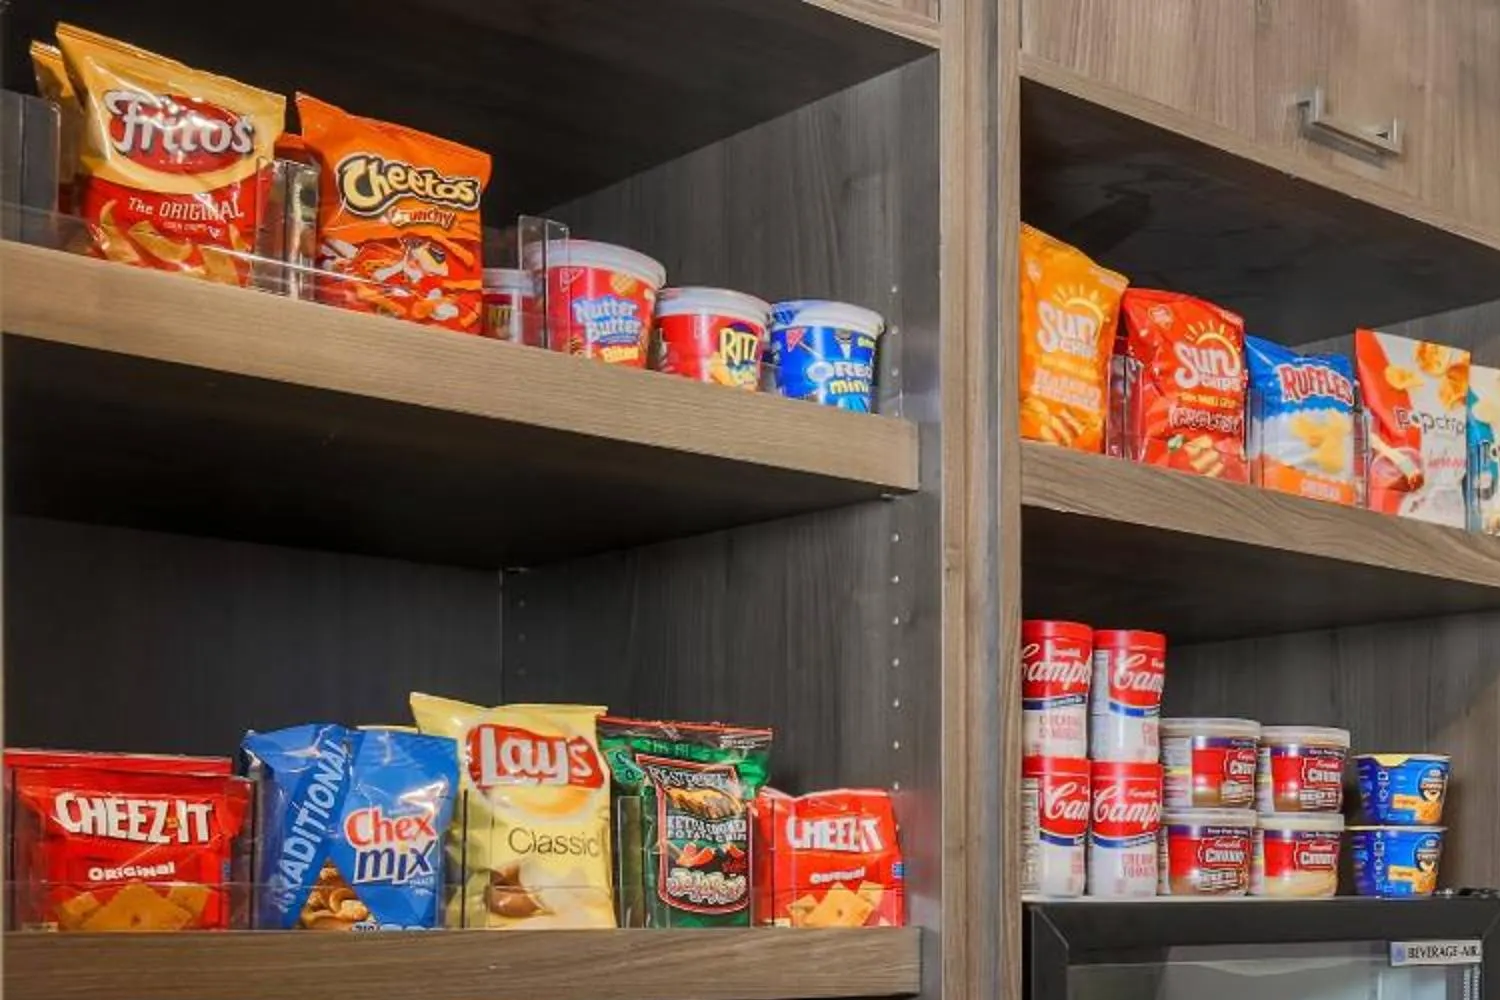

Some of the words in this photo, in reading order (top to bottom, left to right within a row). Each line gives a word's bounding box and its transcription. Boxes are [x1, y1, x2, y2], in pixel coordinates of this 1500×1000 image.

[105, 89, 255, 155] Fritos
[340, 155, 477, 212] Cheetos
[128, 197, 153, 215] The
[160, 199, 245, 222] ORIGINAL
[720, 327, 758, 366] RITZ
[1037, 300, 1096, 352] Sun
[1174, 341, 1240, 389] Sun
[1276, 364, 1354, 406] RUFFLES
[269, 739, 348, 914] TRADITIONAL
[346, 807, 437, 847] Chex
[508, 827, 599, 858] Classic
